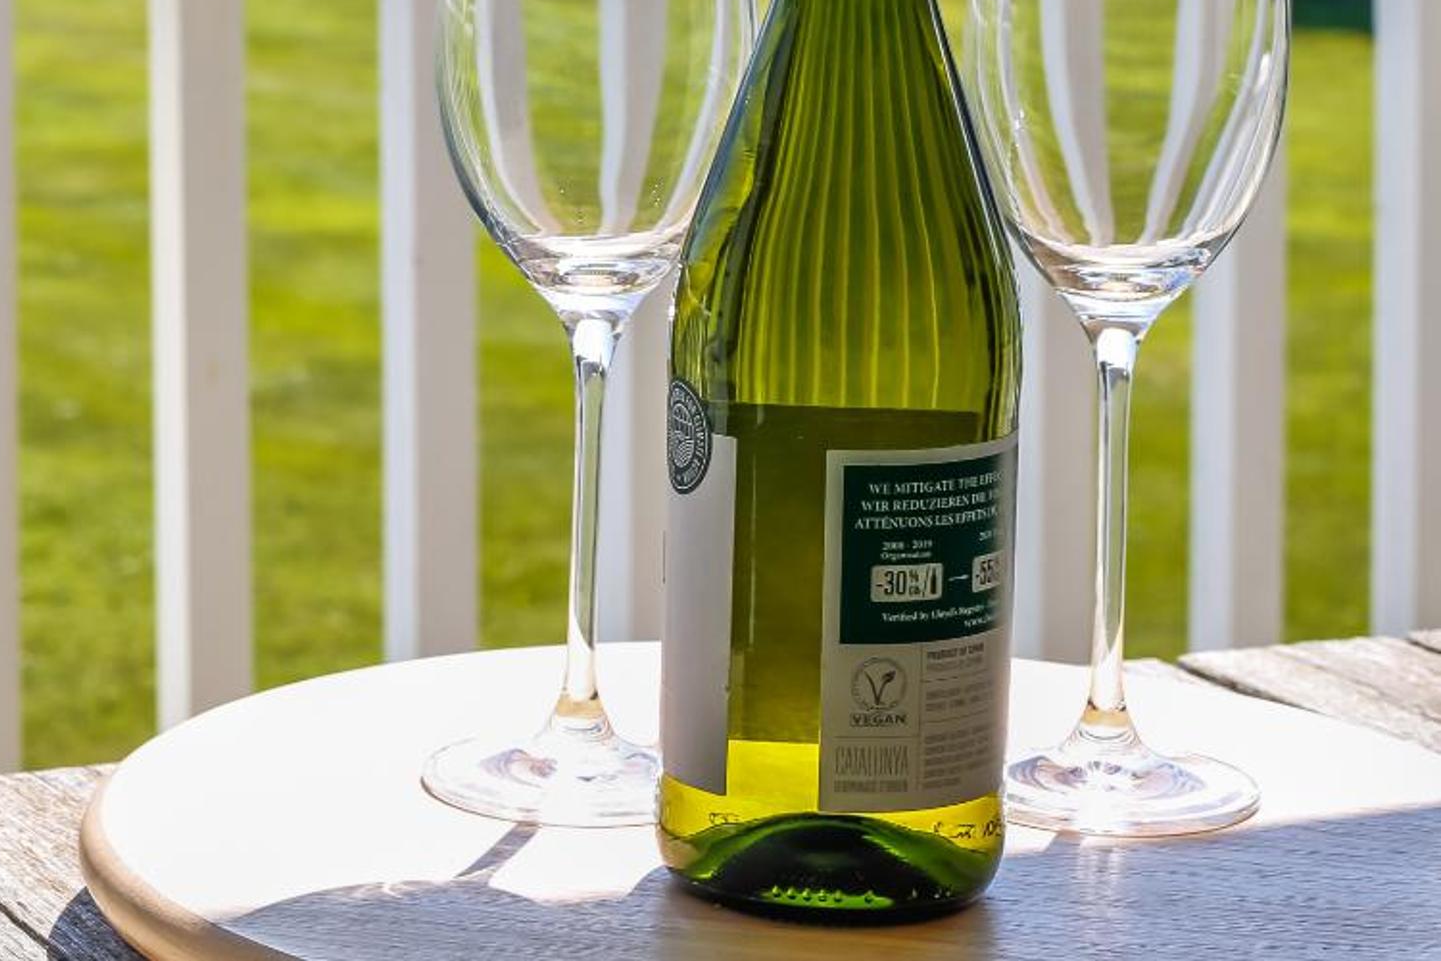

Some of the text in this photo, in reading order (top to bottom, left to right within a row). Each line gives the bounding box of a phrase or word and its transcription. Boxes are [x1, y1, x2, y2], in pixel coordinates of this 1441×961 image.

[868, 483, 888, 495] WE
[895, 479, 953, 494] MITIGATE
[861, 500, 889, 512] WIR
[893, 494, 969, 511] REDUZIEREN
[934, 513, 954, 526] LES
[875, 570, 907, 595] -30
[881, 611, 918, 623] Verified
[851, 713, 907, 725] VEGAN
[835, 745, 908, 776] CATALUNYA
